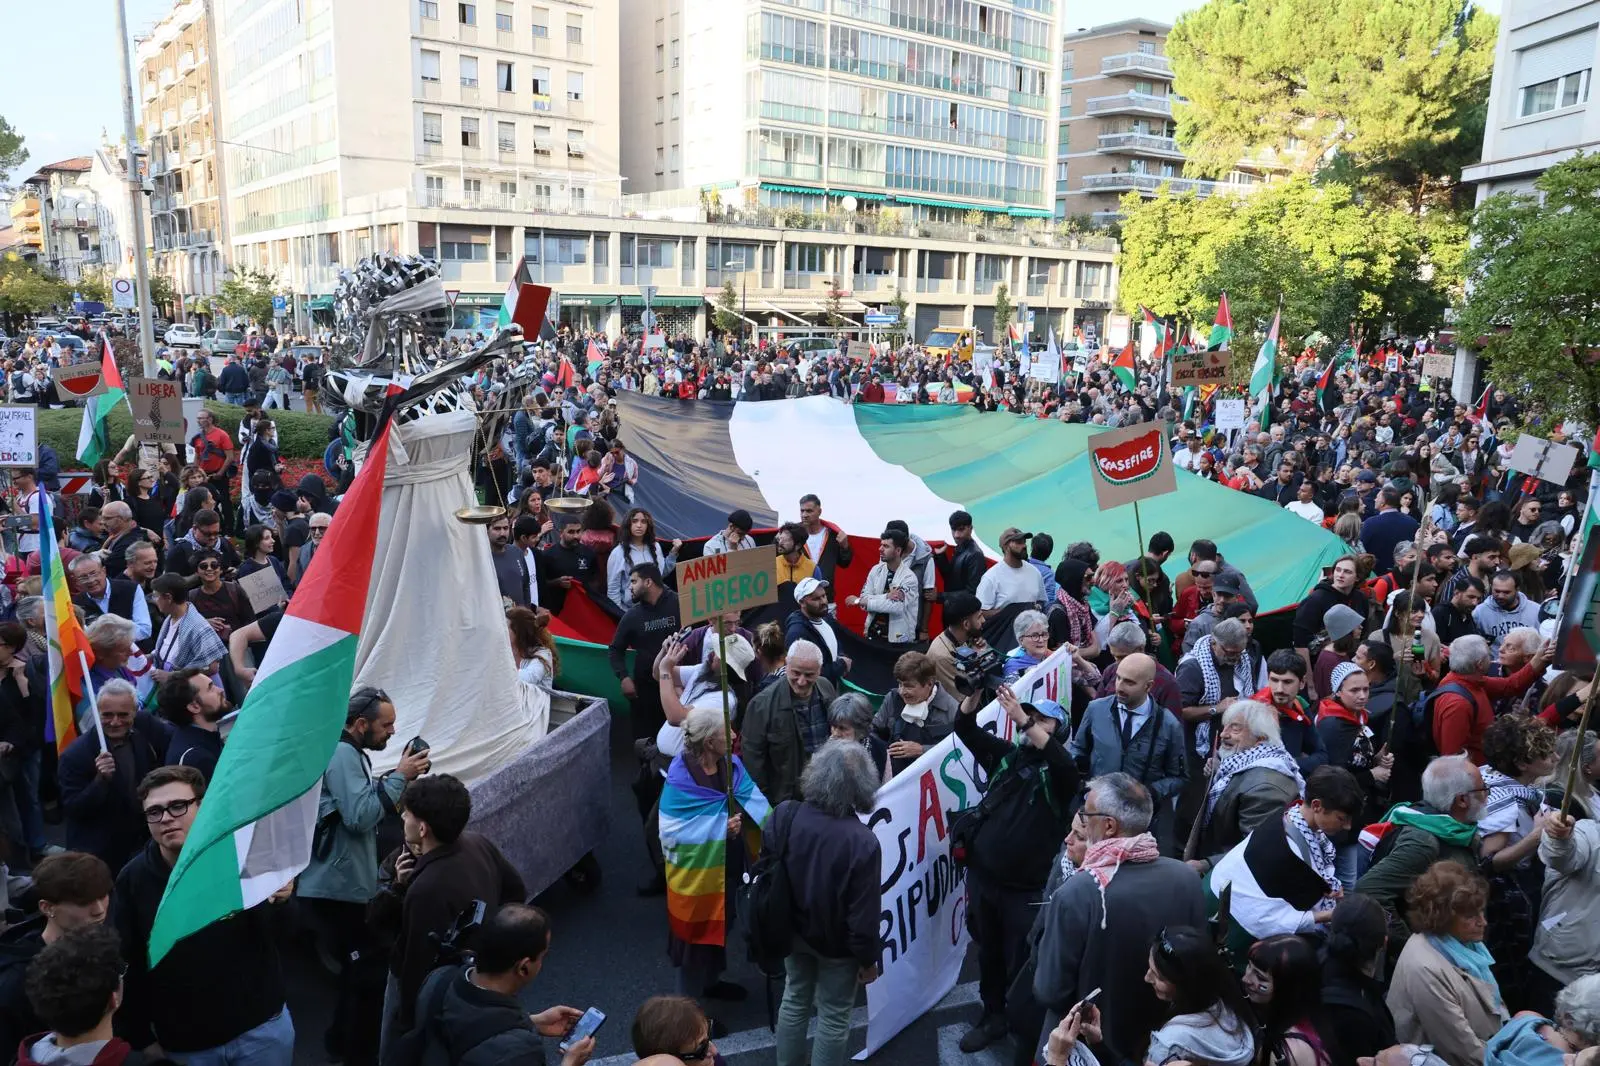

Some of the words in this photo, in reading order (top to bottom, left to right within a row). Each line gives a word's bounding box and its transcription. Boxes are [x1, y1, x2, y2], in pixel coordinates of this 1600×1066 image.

[275, 297, 284, 308] P
[1028, 311, 1035, 320] P
[138, 383, 177, 398] LIBERA
[683, 554, 727, 585] ANAN
[691, 570, 769, 618] LIBERO
[1491, 621, 1529, 637] OXFO
